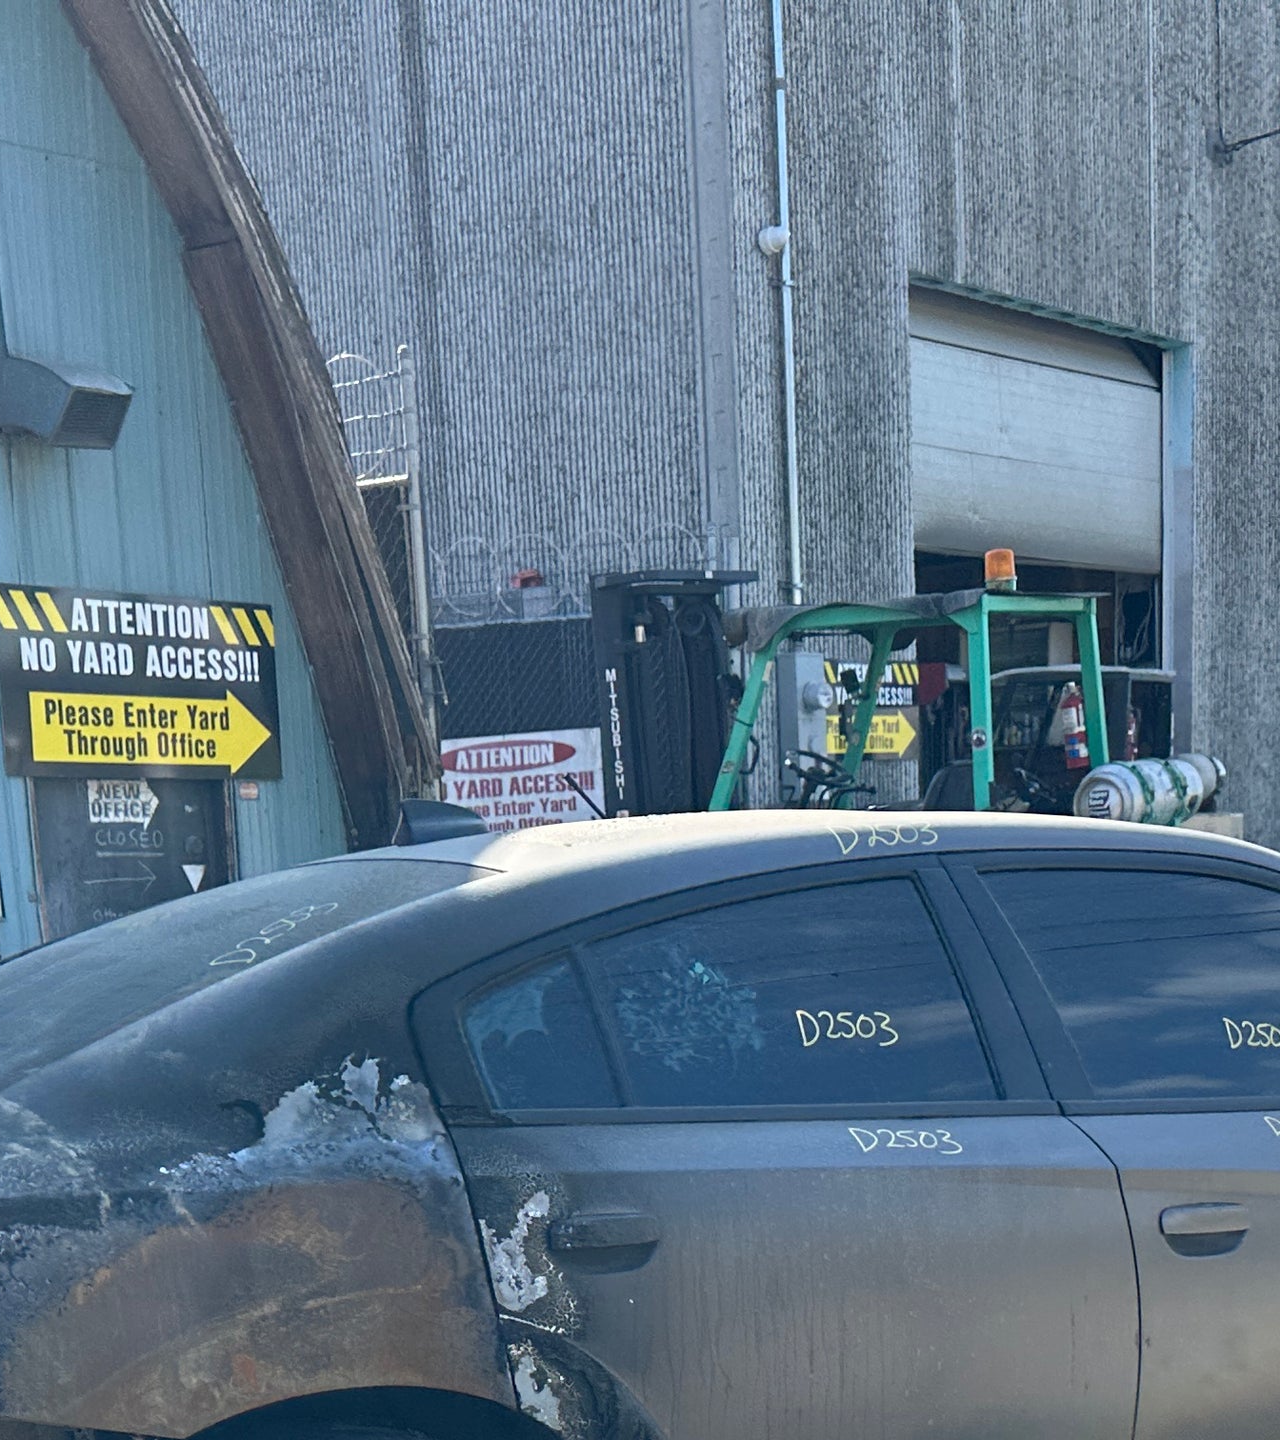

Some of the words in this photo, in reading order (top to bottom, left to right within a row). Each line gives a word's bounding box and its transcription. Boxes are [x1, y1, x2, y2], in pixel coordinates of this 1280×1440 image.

[71, 598, 210, 641] ATTENTION
[20, 637, 56, 672] NO
[67, 640, 134, 677] YARD
[146, 645, 260, 683] ACCESS!!!
[44, 698, 114, 727] Please
[124, 702, 178, 731] Enter
[187, 705, 230, 731] Yard
[63, 729, 148, 761] Through
[157, 733, 217, 759] Office
[605, 668, 625, 800] MITSUBISHI
[455, 743, 555, 771] ATTENTION
[97, 783, 140, 799] NEW
[453, 778, 503, 801] YARD
[91, 799, 151, 819] OFFICE
[494, 801, 535, 817] Enter
[539, 796, 577, 813] Yard
[95, 828, 164, 848] CLOSED
[825, 821, 938, 855] D2503
[795, 1009, 899, 1047] D2503
[848, 1127, 963, 1155] D2503
